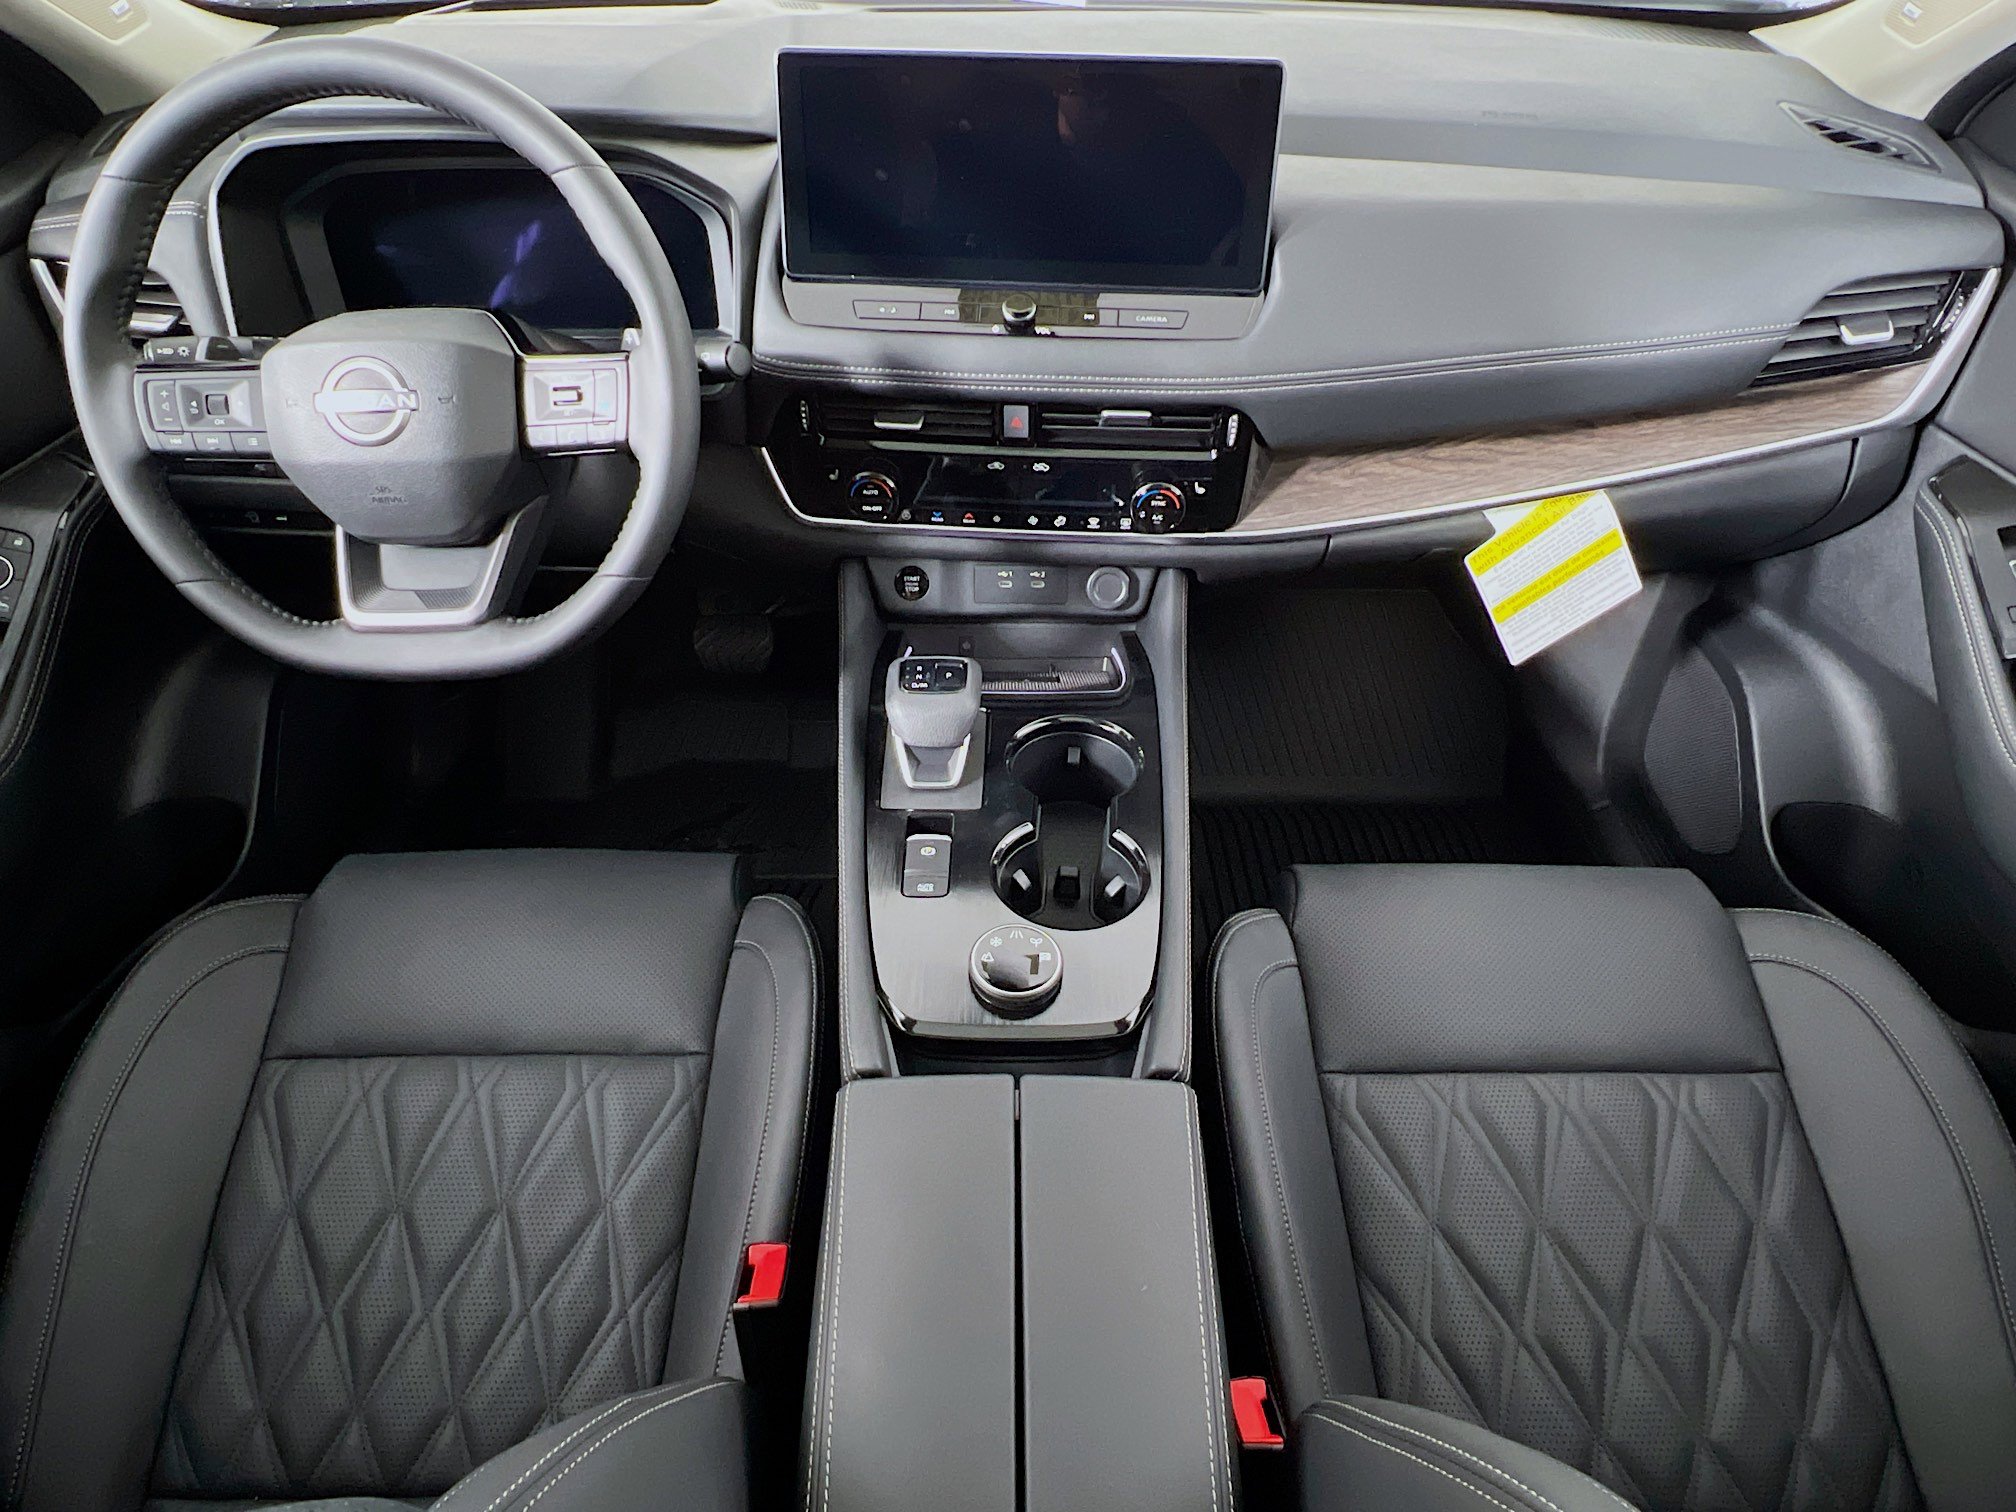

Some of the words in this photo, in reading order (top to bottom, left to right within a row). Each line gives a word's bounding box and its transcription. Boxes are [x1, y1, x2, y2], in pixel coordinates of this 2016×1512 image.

[1135, 315, 1168, 323] CAMERA
[1471, 546, 1492, 564] This
[1494, 518, 1531, 547] Vehicle
[1476, 554, 1498, 572] with
[1500, 517, 1550, 555] Advanced
[1552, 505, 1567, 519] Air
